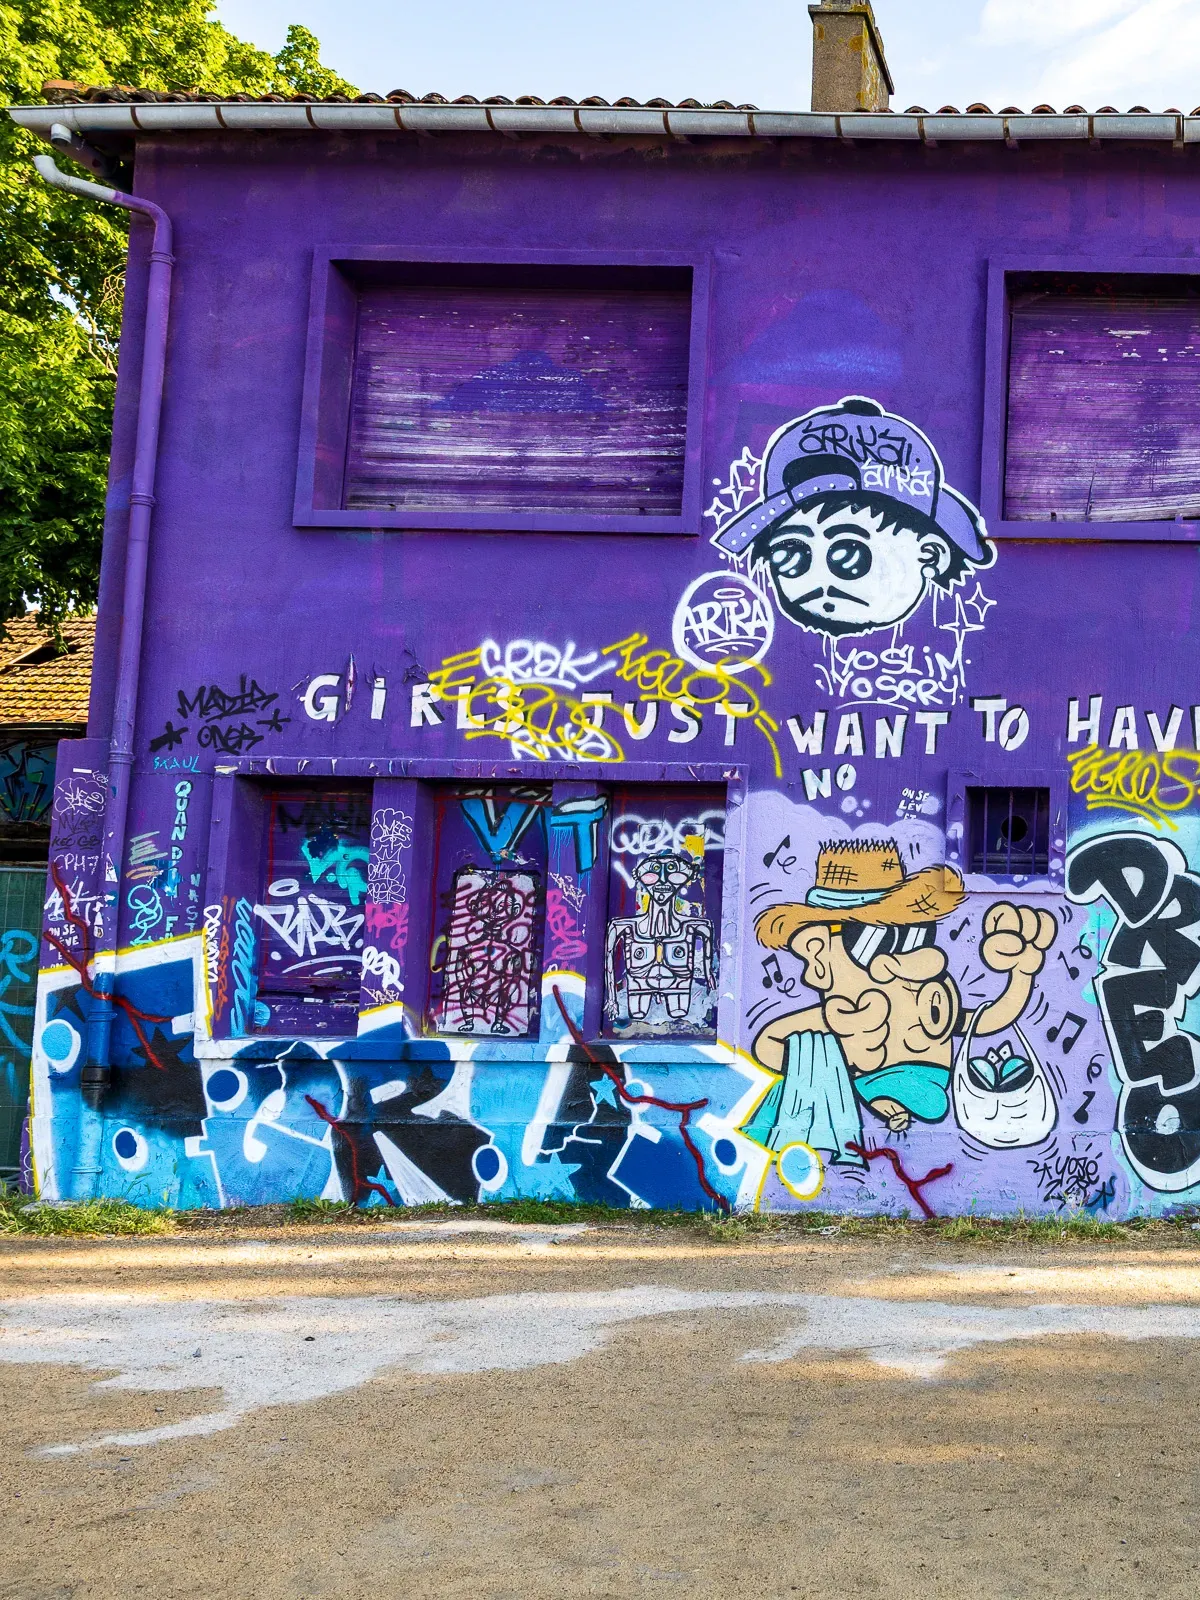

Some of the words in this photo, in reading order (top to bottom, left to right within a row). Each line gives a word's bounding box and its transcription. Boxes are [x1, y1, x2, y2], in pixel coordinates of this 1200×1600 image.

[580, 690, 756, 747] JUST
[785, 709, 952, 759] WANT
[970, 695, 1030, 752] TO
[802, 763, 857, 801] NO
[902, 787, 916, 800] ON
[915, 790, 930, 802] SE
[171, 780, 193, 860] QUAND
[63, 924, 76, 936] SE
